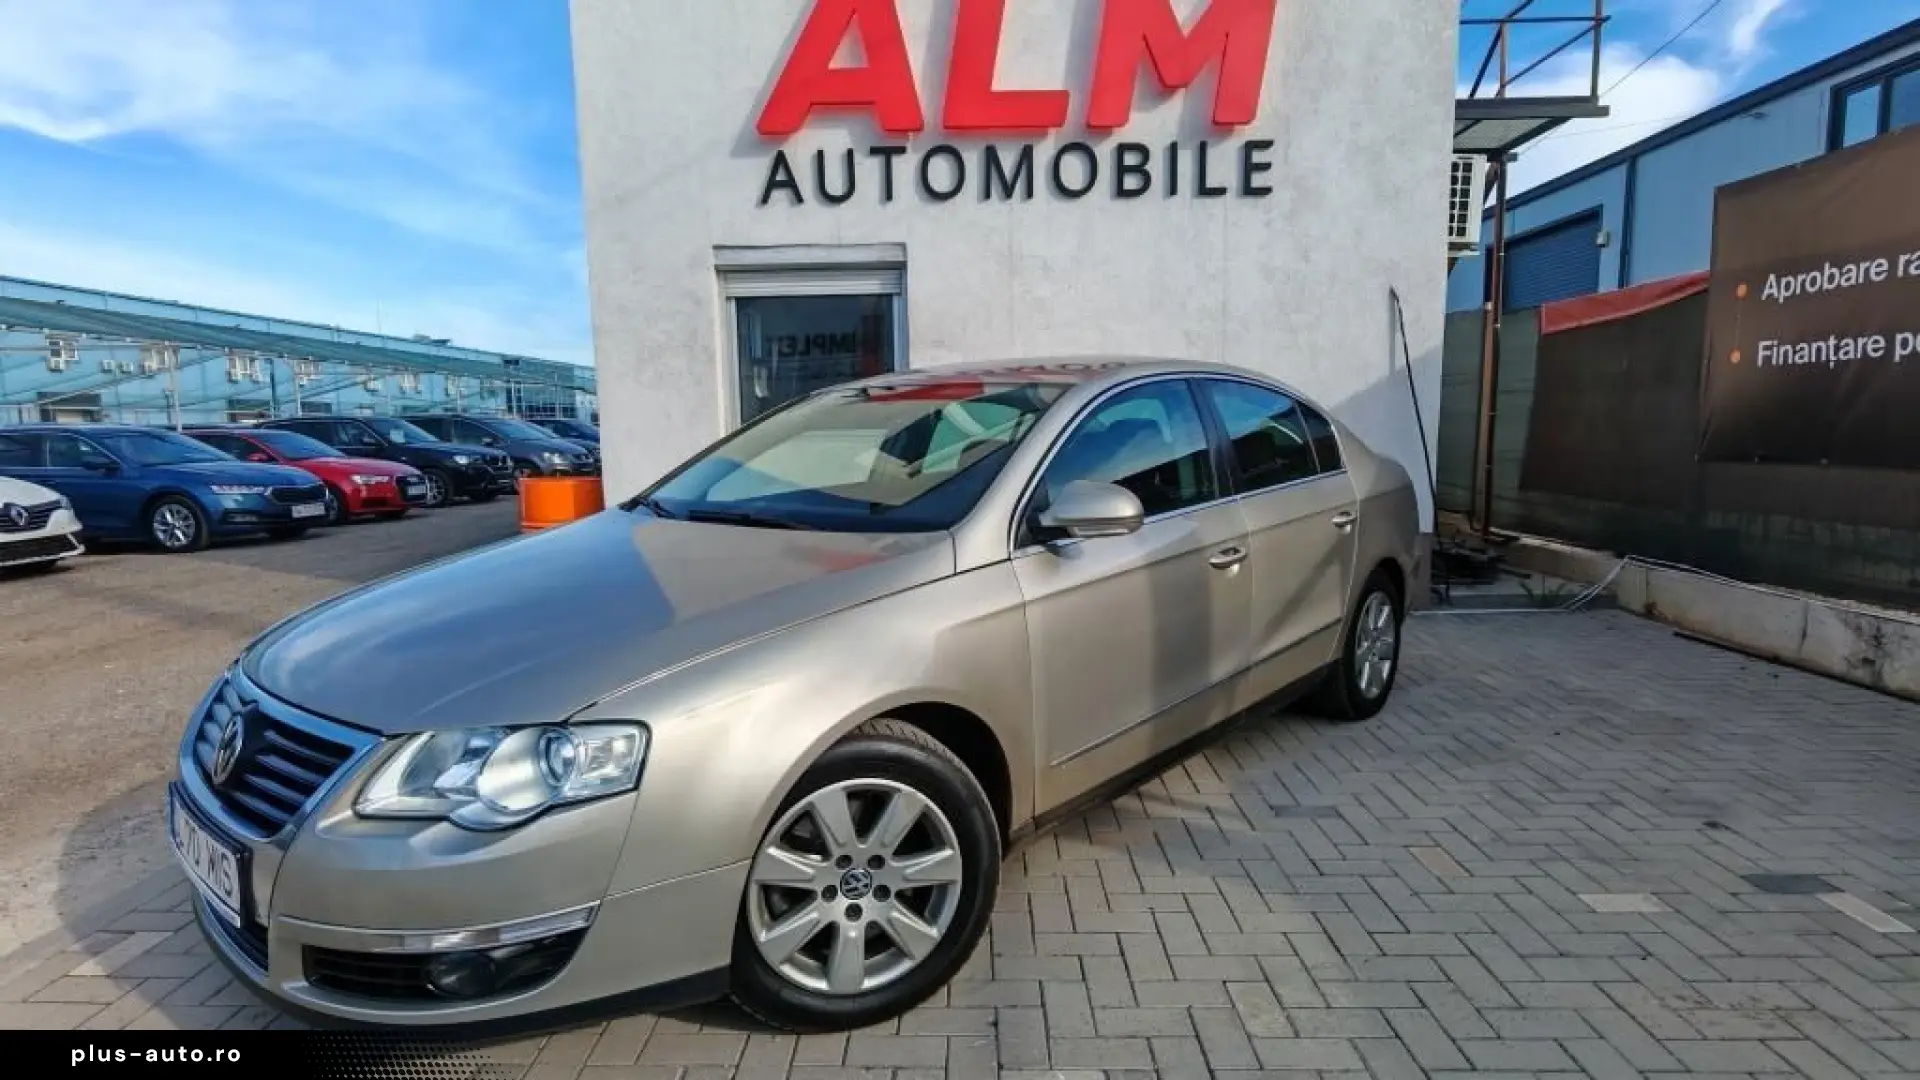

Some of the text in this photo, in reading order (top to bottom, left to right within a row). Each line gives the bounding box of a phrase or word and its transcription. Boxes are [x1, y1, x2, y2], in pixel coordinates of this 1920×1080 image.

[756, 0, 1277, 134] ALM
[760, 139, 1274, 205] AUTOMOBILE
[1761, 257, 1889, 303] Aprobare
[1757, 334, 1886, 369] Finanțare
